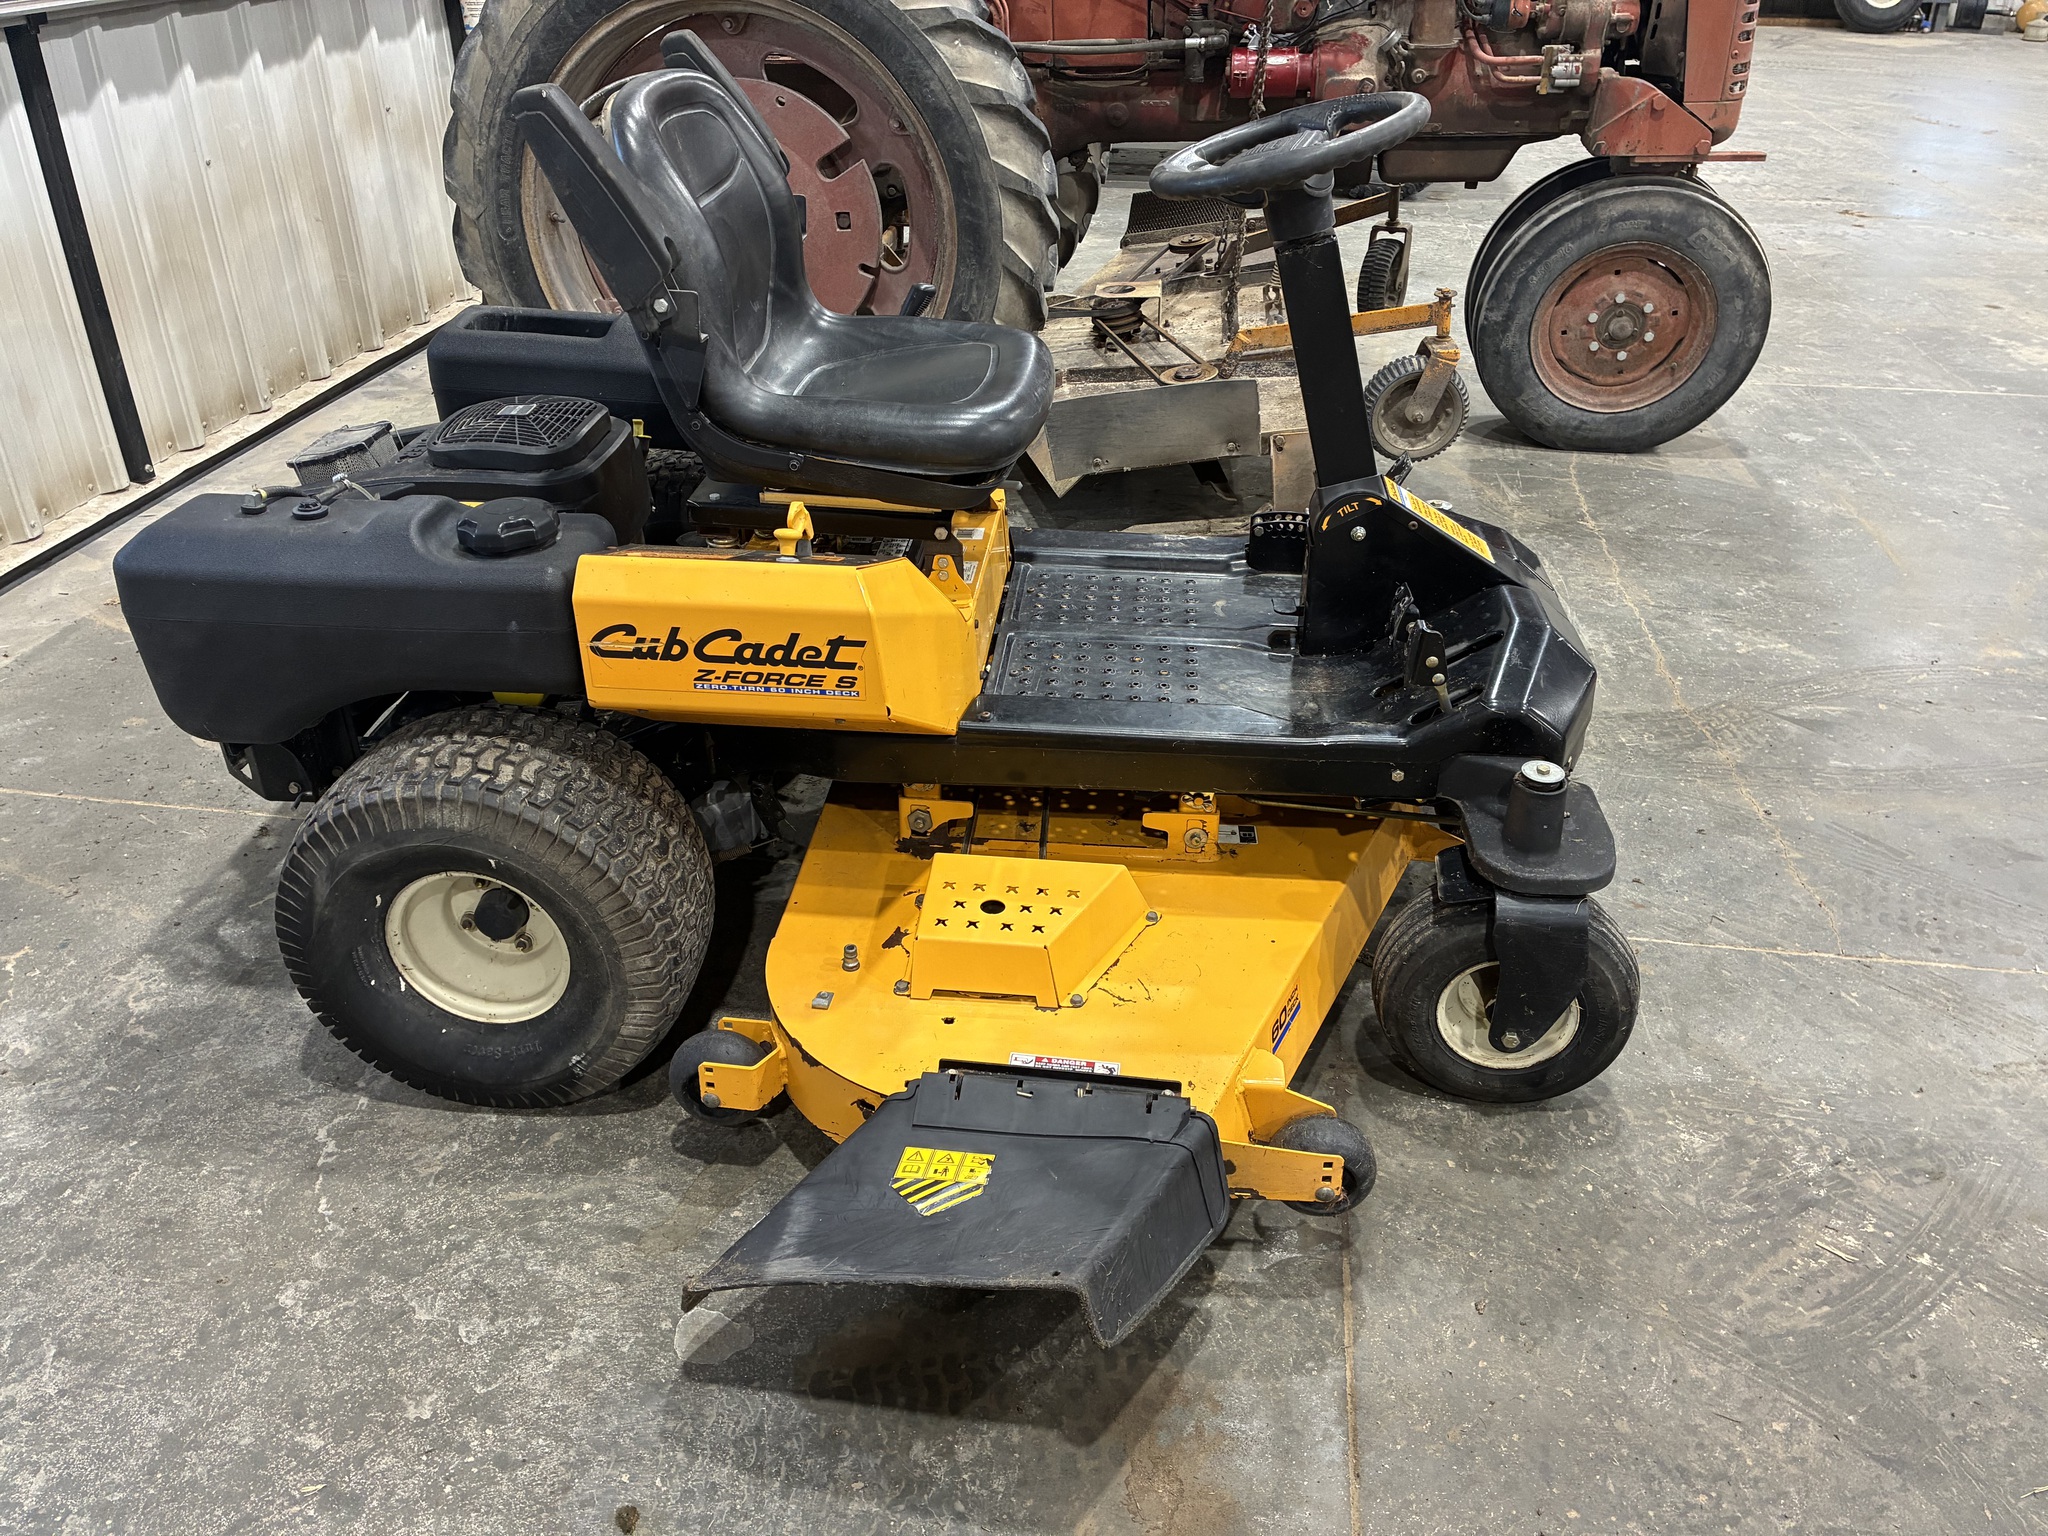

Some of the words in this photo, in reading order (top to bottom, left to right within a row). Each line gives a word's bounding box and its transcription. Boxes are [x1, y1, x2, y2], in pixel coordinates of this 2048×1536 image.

[1336, 501, 1360, 518] TILT
[588, 623, 689, 662] Cub
[693, 628, 867, 671] Cadet
[693, 668, 828, 688] Z-FORCE
[835, 675, 858, 689] S
[695, 683, 765, 692] ZERO-TURN
[825, 689, 859, 697] DECK
[1272, 1004, 1288, 1044] 60
[1051, 1058, 1087, 1067] DANGER
